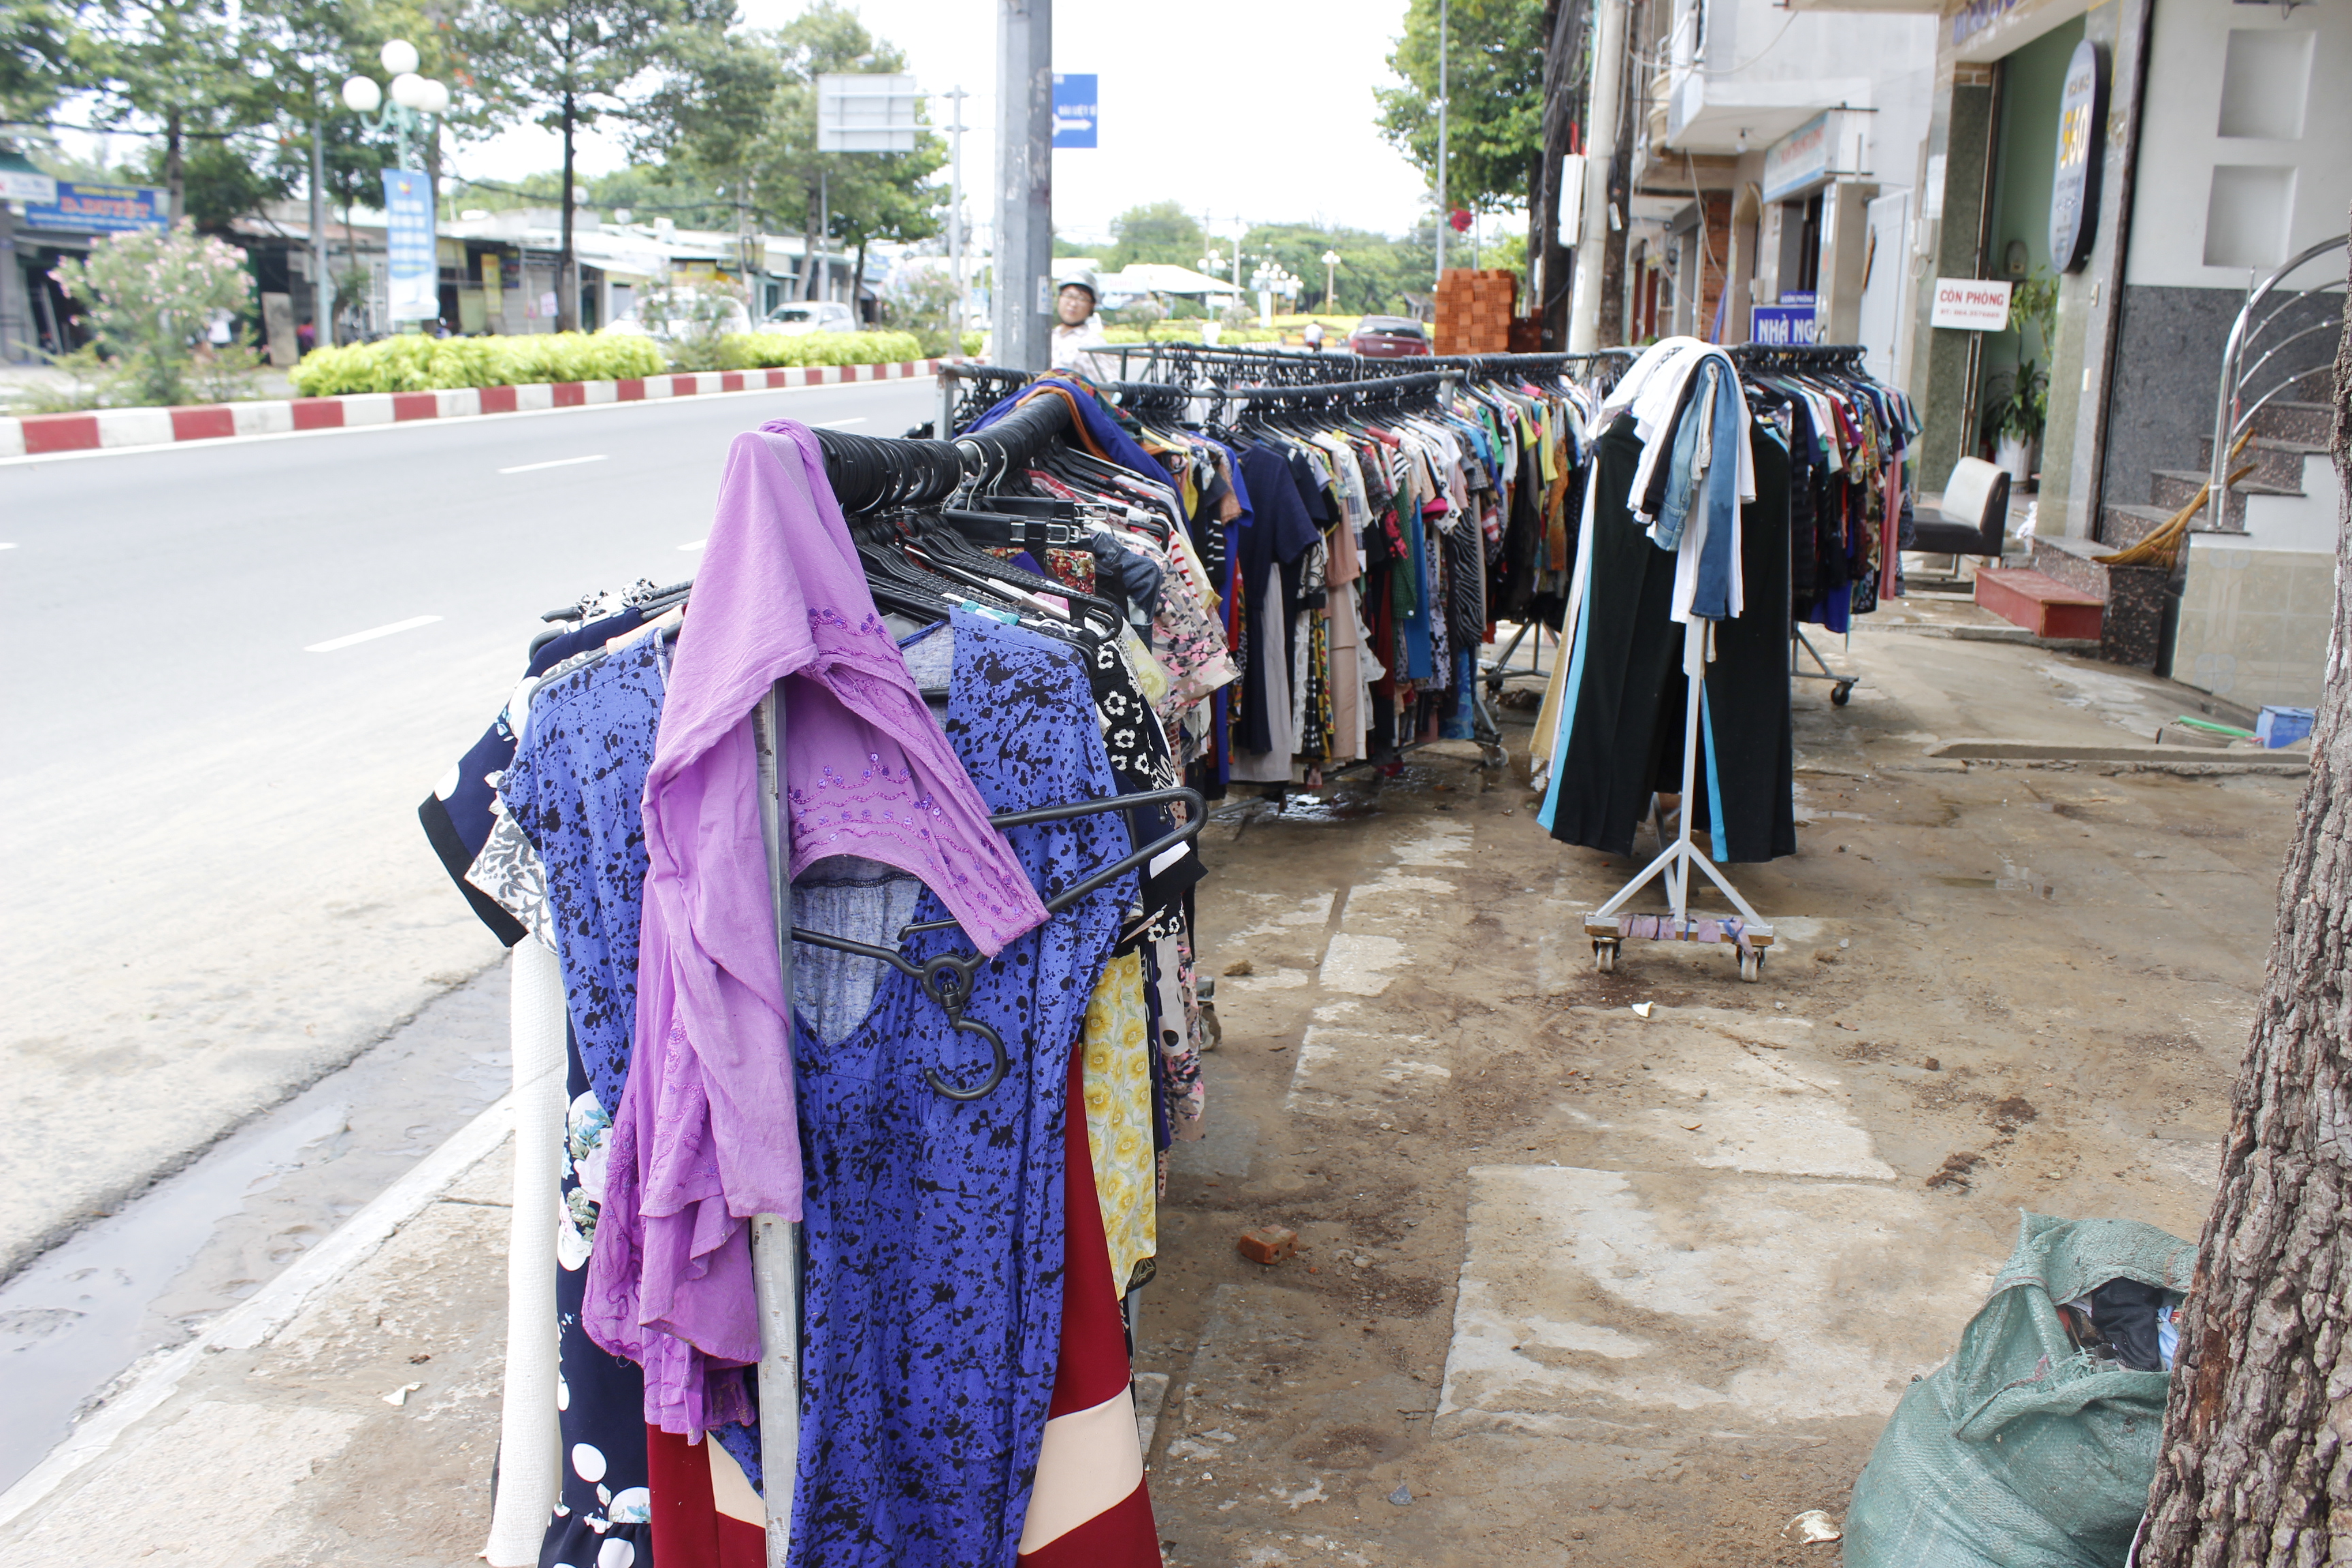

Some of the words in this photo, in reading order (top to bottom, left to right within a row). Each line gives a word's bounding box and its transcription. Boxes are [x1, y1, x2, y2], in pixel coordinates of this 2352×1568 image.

[1940, 287, 1963, 303] CÒN
[1966, 289, 2004, 306] PHÒNG
[1758, 313, 1789, 345] NHÀ
